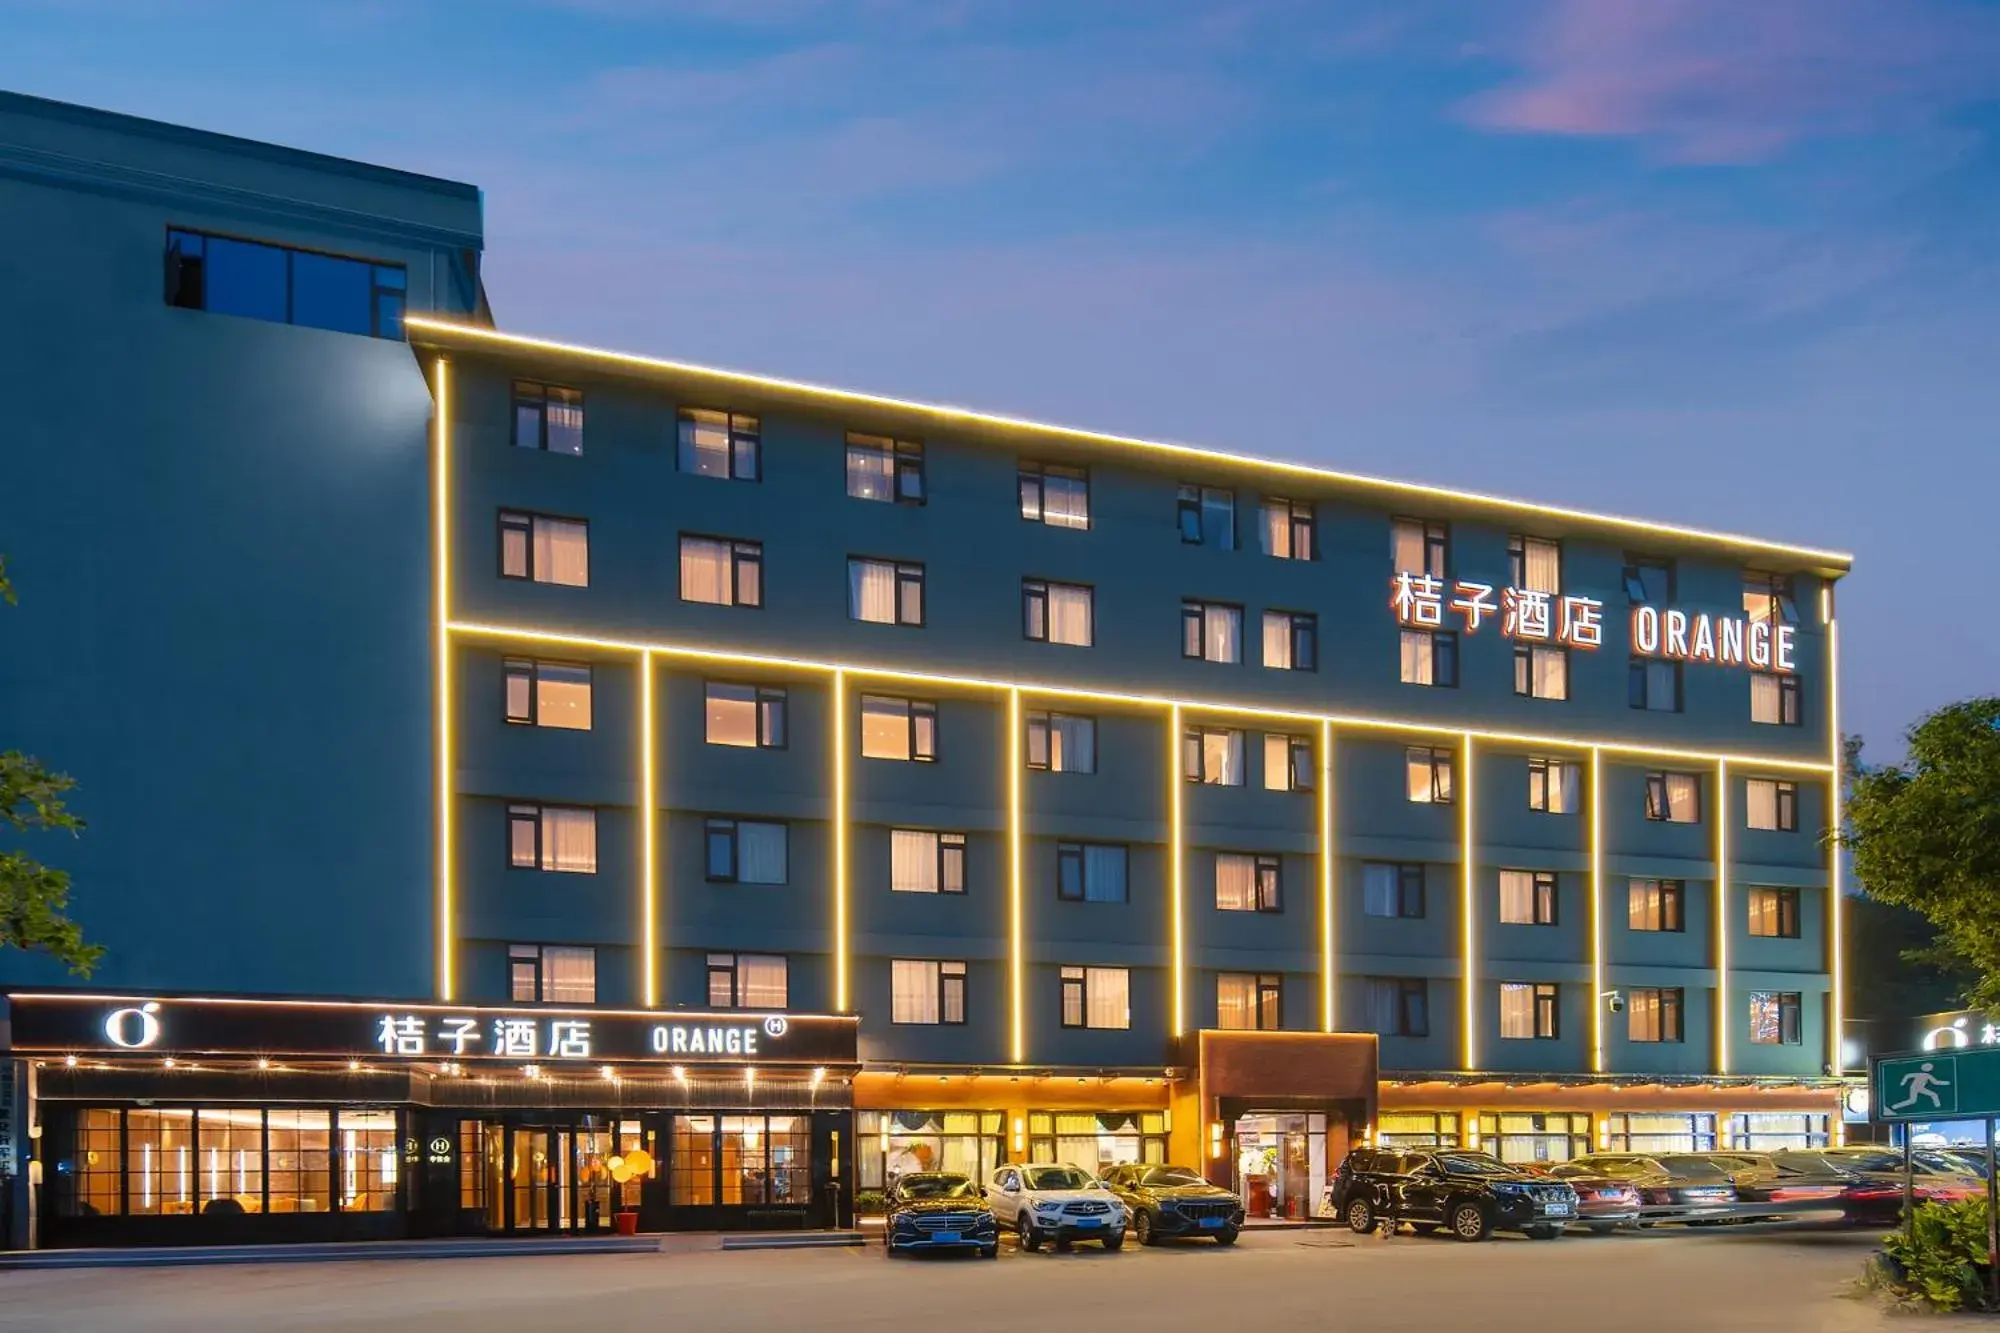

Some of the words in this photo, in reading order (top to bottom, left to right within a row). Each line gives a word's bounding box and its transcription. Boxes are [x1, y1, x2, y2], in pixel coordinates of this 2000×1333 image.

[1392, 572, 1603, 646] 桔子酒店
[1633, 606, 1796, 671] ORANGE
[378, 1015, 592, 1057] 桔子酒店
[652, 1026, 758, 1054] ORANGE
